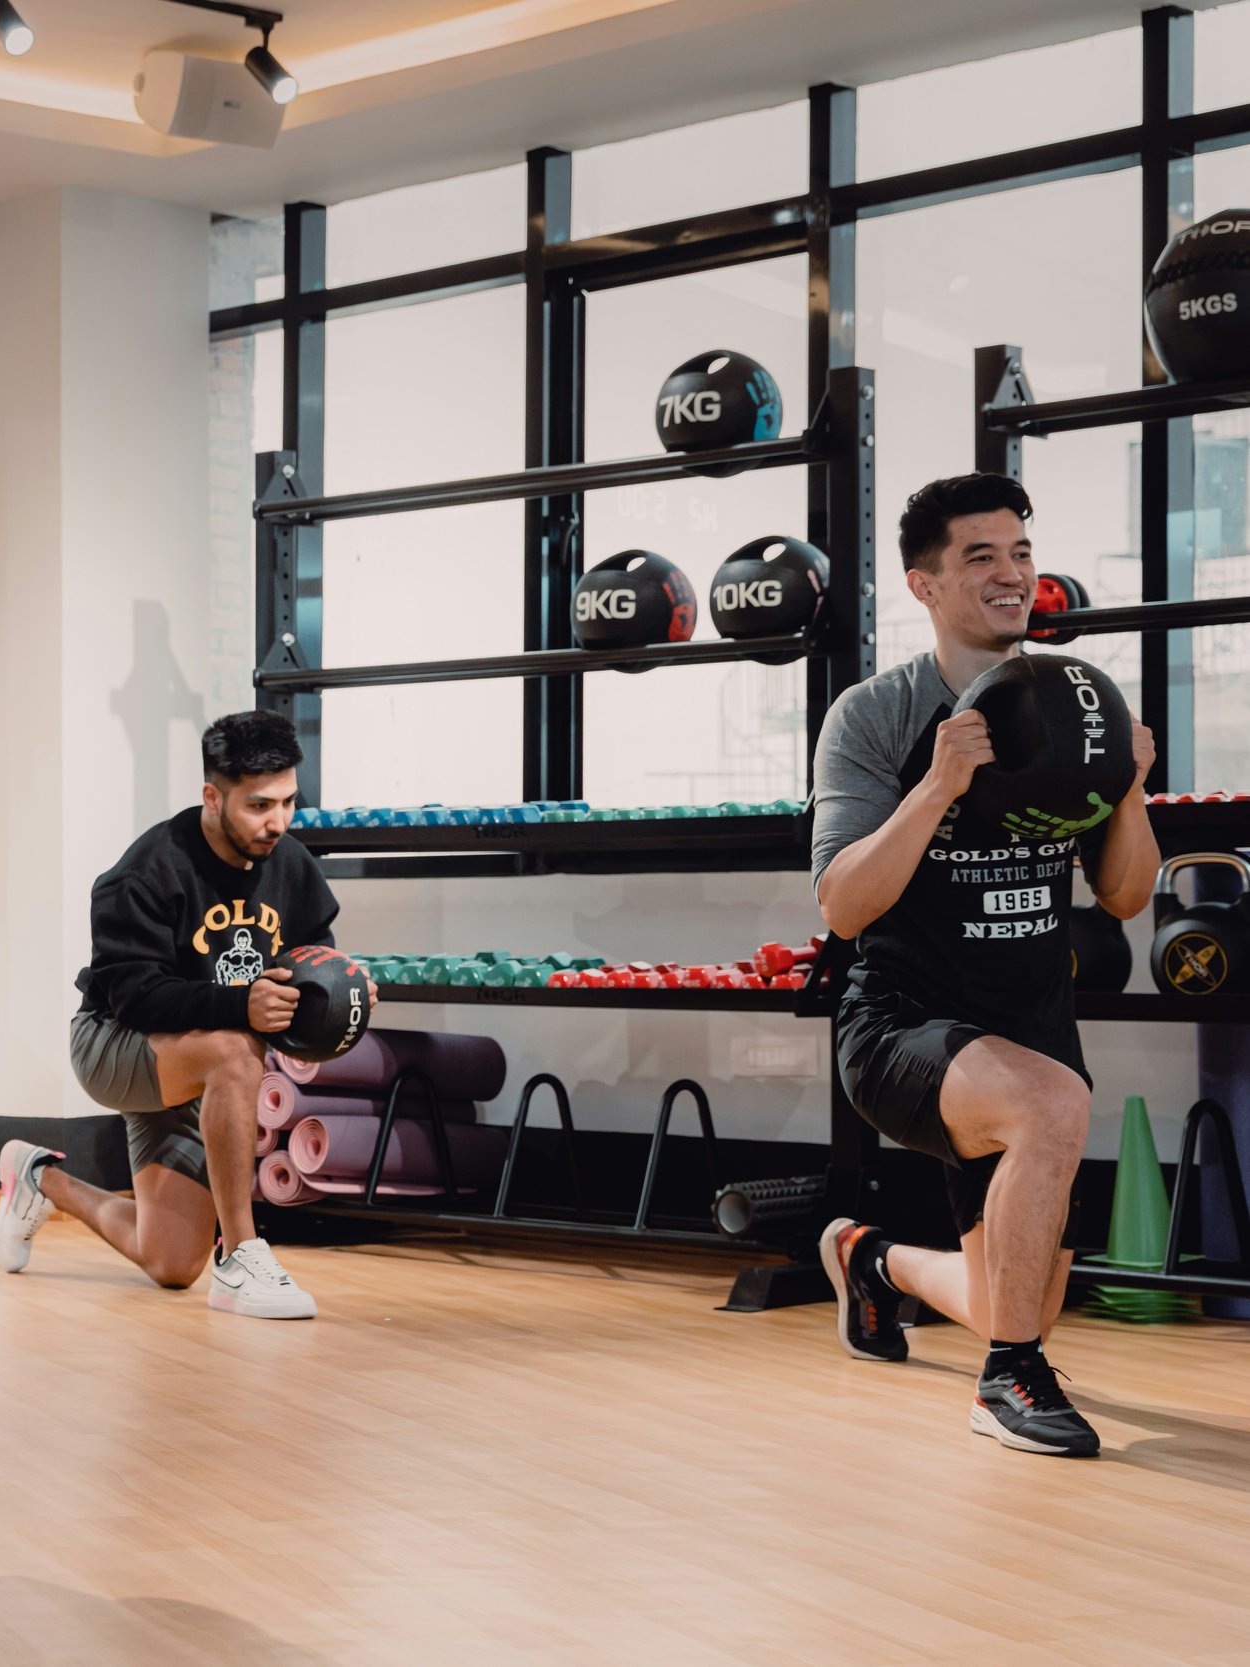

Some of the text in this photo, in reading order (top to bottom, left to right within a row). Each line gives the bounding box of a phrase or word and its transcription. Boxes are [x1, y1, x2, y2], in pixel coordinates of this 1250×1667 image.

[1179, 292, 1238, 321] 5KGS
[659, 391, 722, 428] 7KG
[576, 588, 637, 622] 9KG
[713, 579, 783, 612] 10KG
[1064, 665, 1105, 764] THOR
[928, 846, 1031, 862] GOLD'S
[951, 866, 1029, 884] ATHLETIC
[994, 889, 1042, 912] 1965
[961, 913, 1058, 939] NEPAL
[335, 988, 361, 1052] THOR
